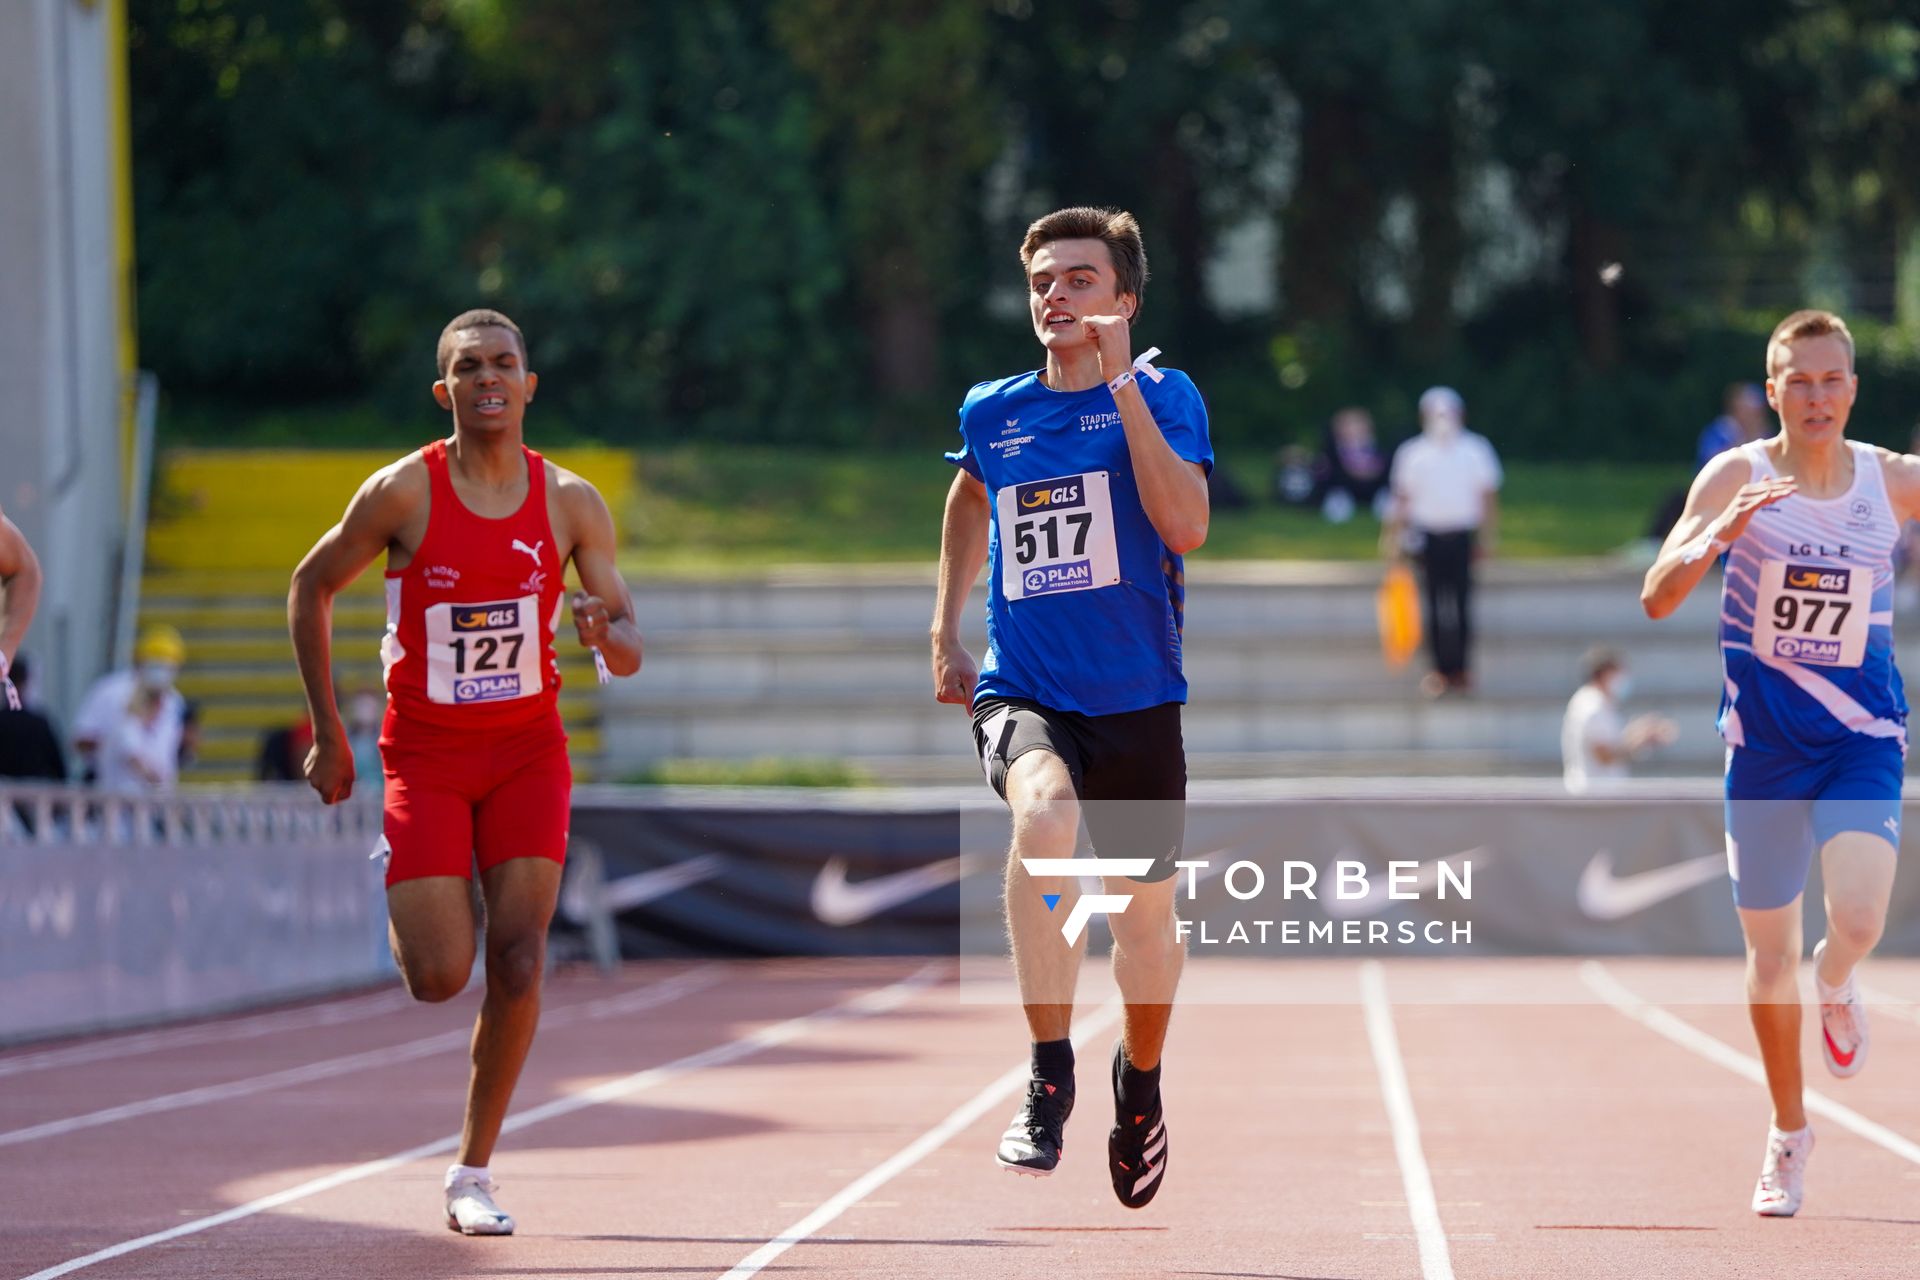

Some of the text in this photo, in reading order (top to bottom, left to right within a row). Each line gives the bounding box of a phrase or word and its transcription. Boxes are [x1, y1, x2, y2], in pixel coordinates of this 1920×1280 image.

[997, 436, 1032, 448] INTERSPORT
[1051, 486, 1078, 504] GLS
[1015, 512, 1092, 564] 517
[1789, 544, 1811, 556] LG
[1048, 566, 1088, 582] PLAN
[1818, 574, 1846, 590] GLS
[1049, 579, 1089, 588] INTERNATIONAL
[487, 609, 515, 626] GLS
[1773, 595, 1852, 635] 977
[448, 633, 524, 673] 127
[1801, 641, 1839, 655] PLAN
[481, 677, 518, 692] PLAN
